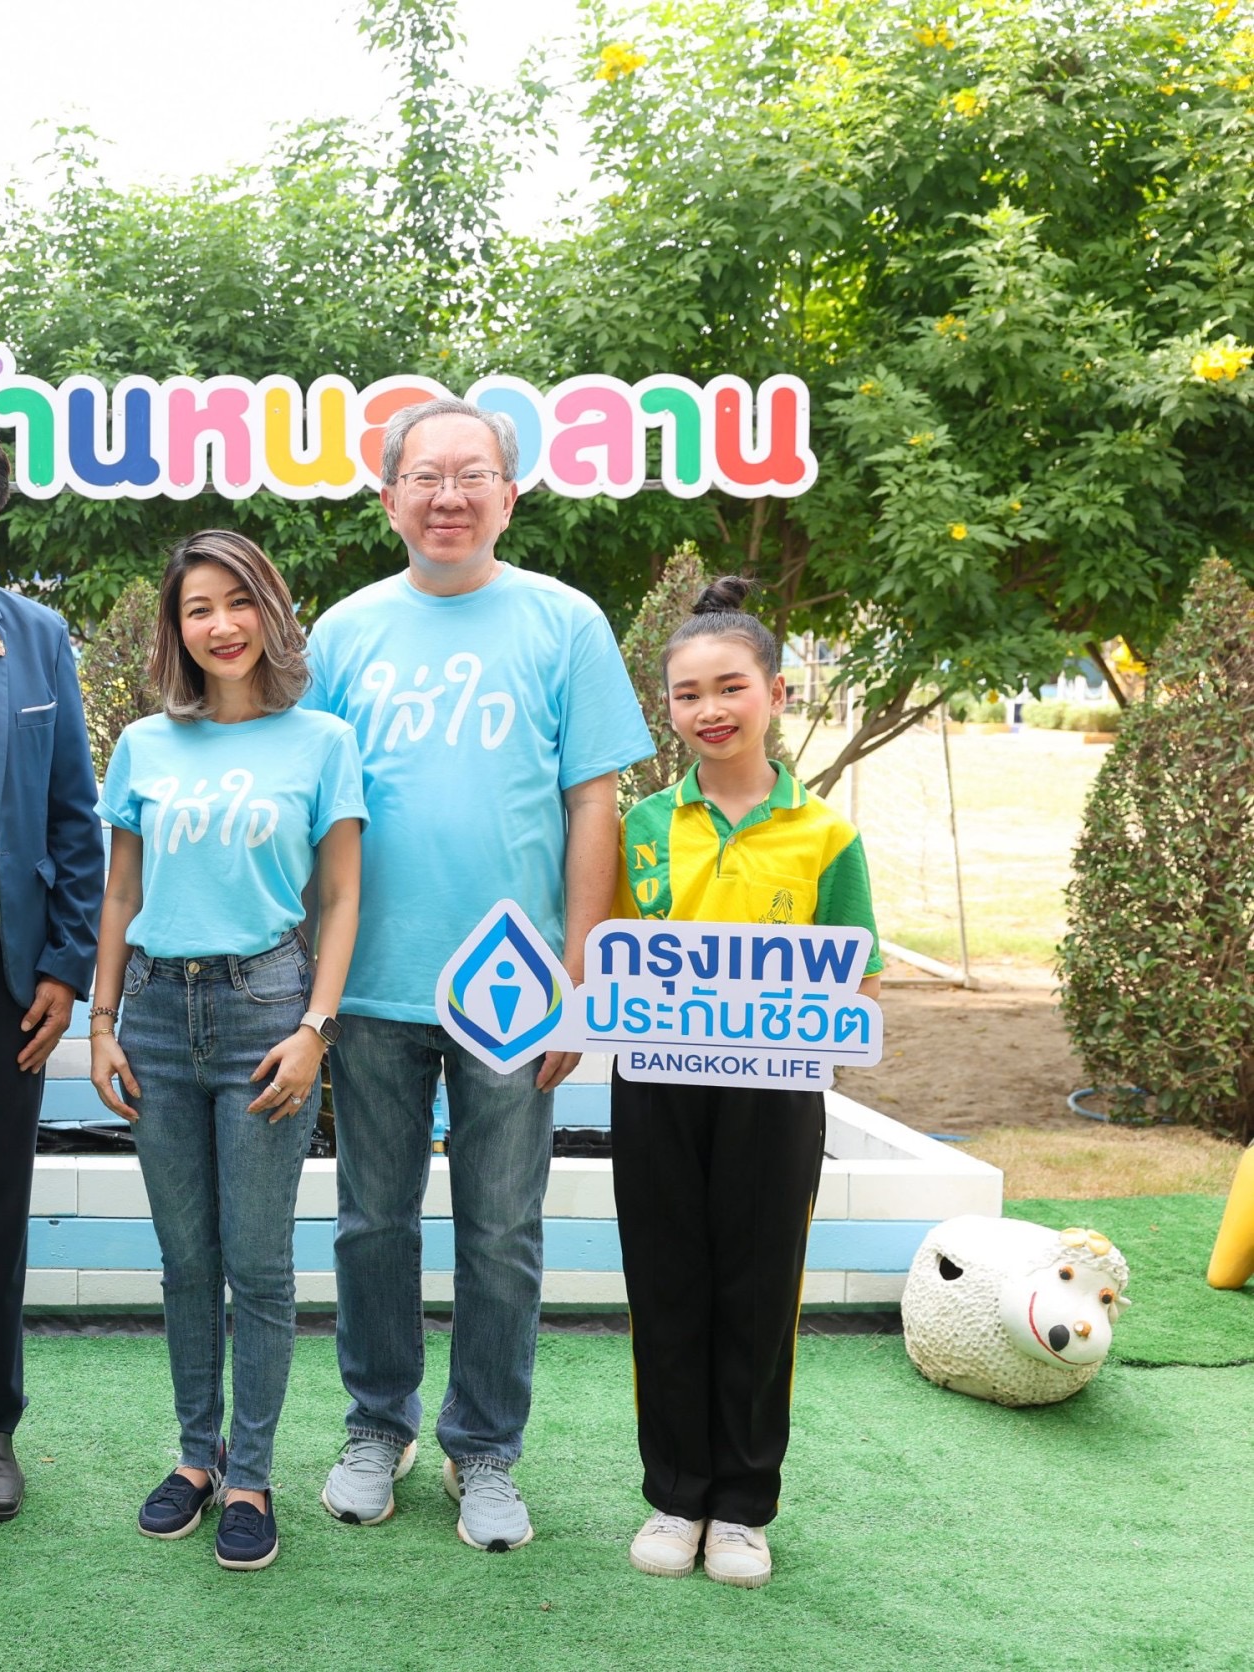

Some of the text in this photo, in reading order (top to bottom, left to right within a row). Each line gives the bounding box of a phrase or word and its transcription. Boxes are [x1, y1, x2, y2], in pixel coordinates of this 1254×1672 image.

[362, 652, 515, 752] ใส่ใจ
[148, 768, 279, 855] ใส่ใจ
[633, 841, 668, 920] NO
[599, 931, 859, 995] กรุงเทพ
[586, 982, 870, 1044] ประกันชีวิต
[630, 1051, 822, 1079] BANGKOK LIFE
